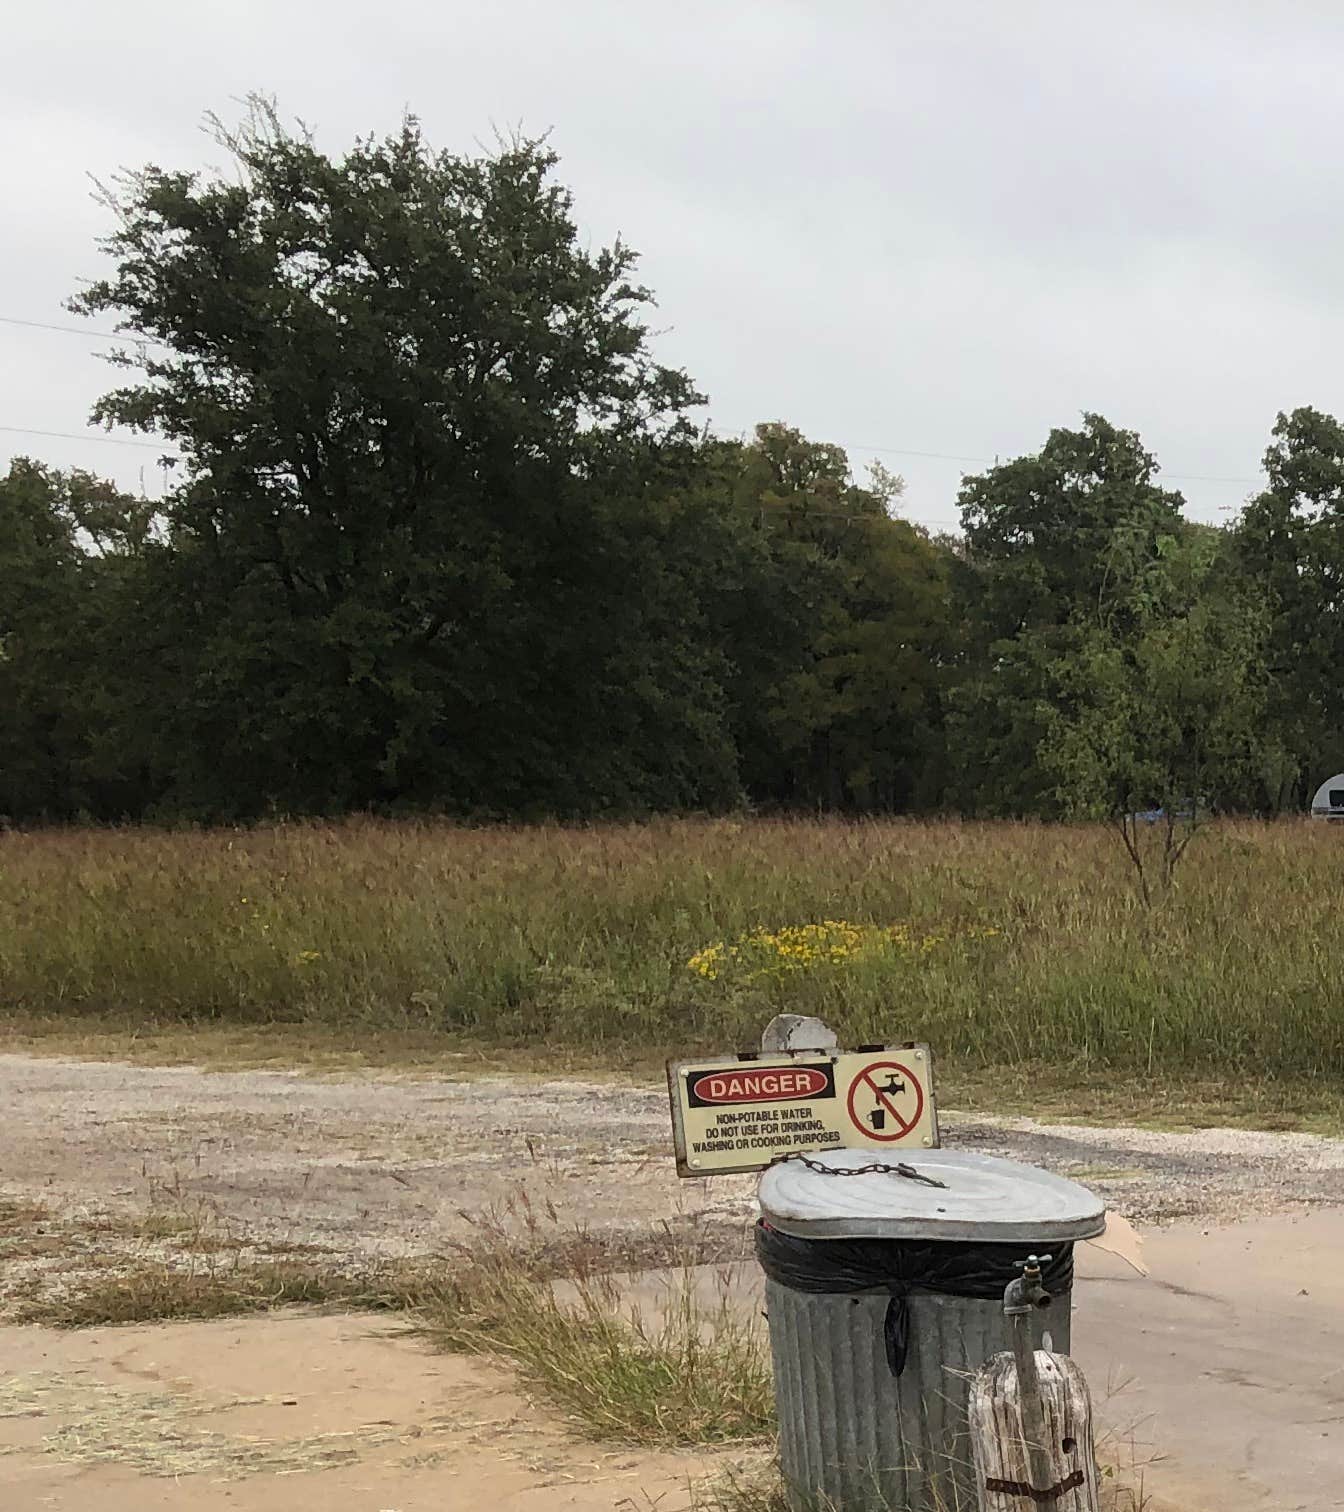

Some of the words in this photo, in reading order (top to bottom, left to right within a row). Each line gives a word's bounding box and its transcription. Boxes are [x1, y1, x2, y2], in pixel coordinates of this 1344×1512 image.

[710, 1073, 812, 1098] DANGER
[716, 1110, 779, 1125] NON-POTABLE
[781, 1107, 812, 1120] WATER
[706, 1128, 719, 1139] DO
[720, 1126, 739, 1138] NOT
[741, 1125, 759, 1137] USE
[761, 1123, 779, 1135] FOR
[781, 1120, 825, 1134] DRINKING,
[693, 1138, 735, 1153] WASHING
[736, 1136, 750, 1149] OR
[751, 1134, 791, 1148] COOKING
[793, 1131, 840, 1145] PURPOSES
